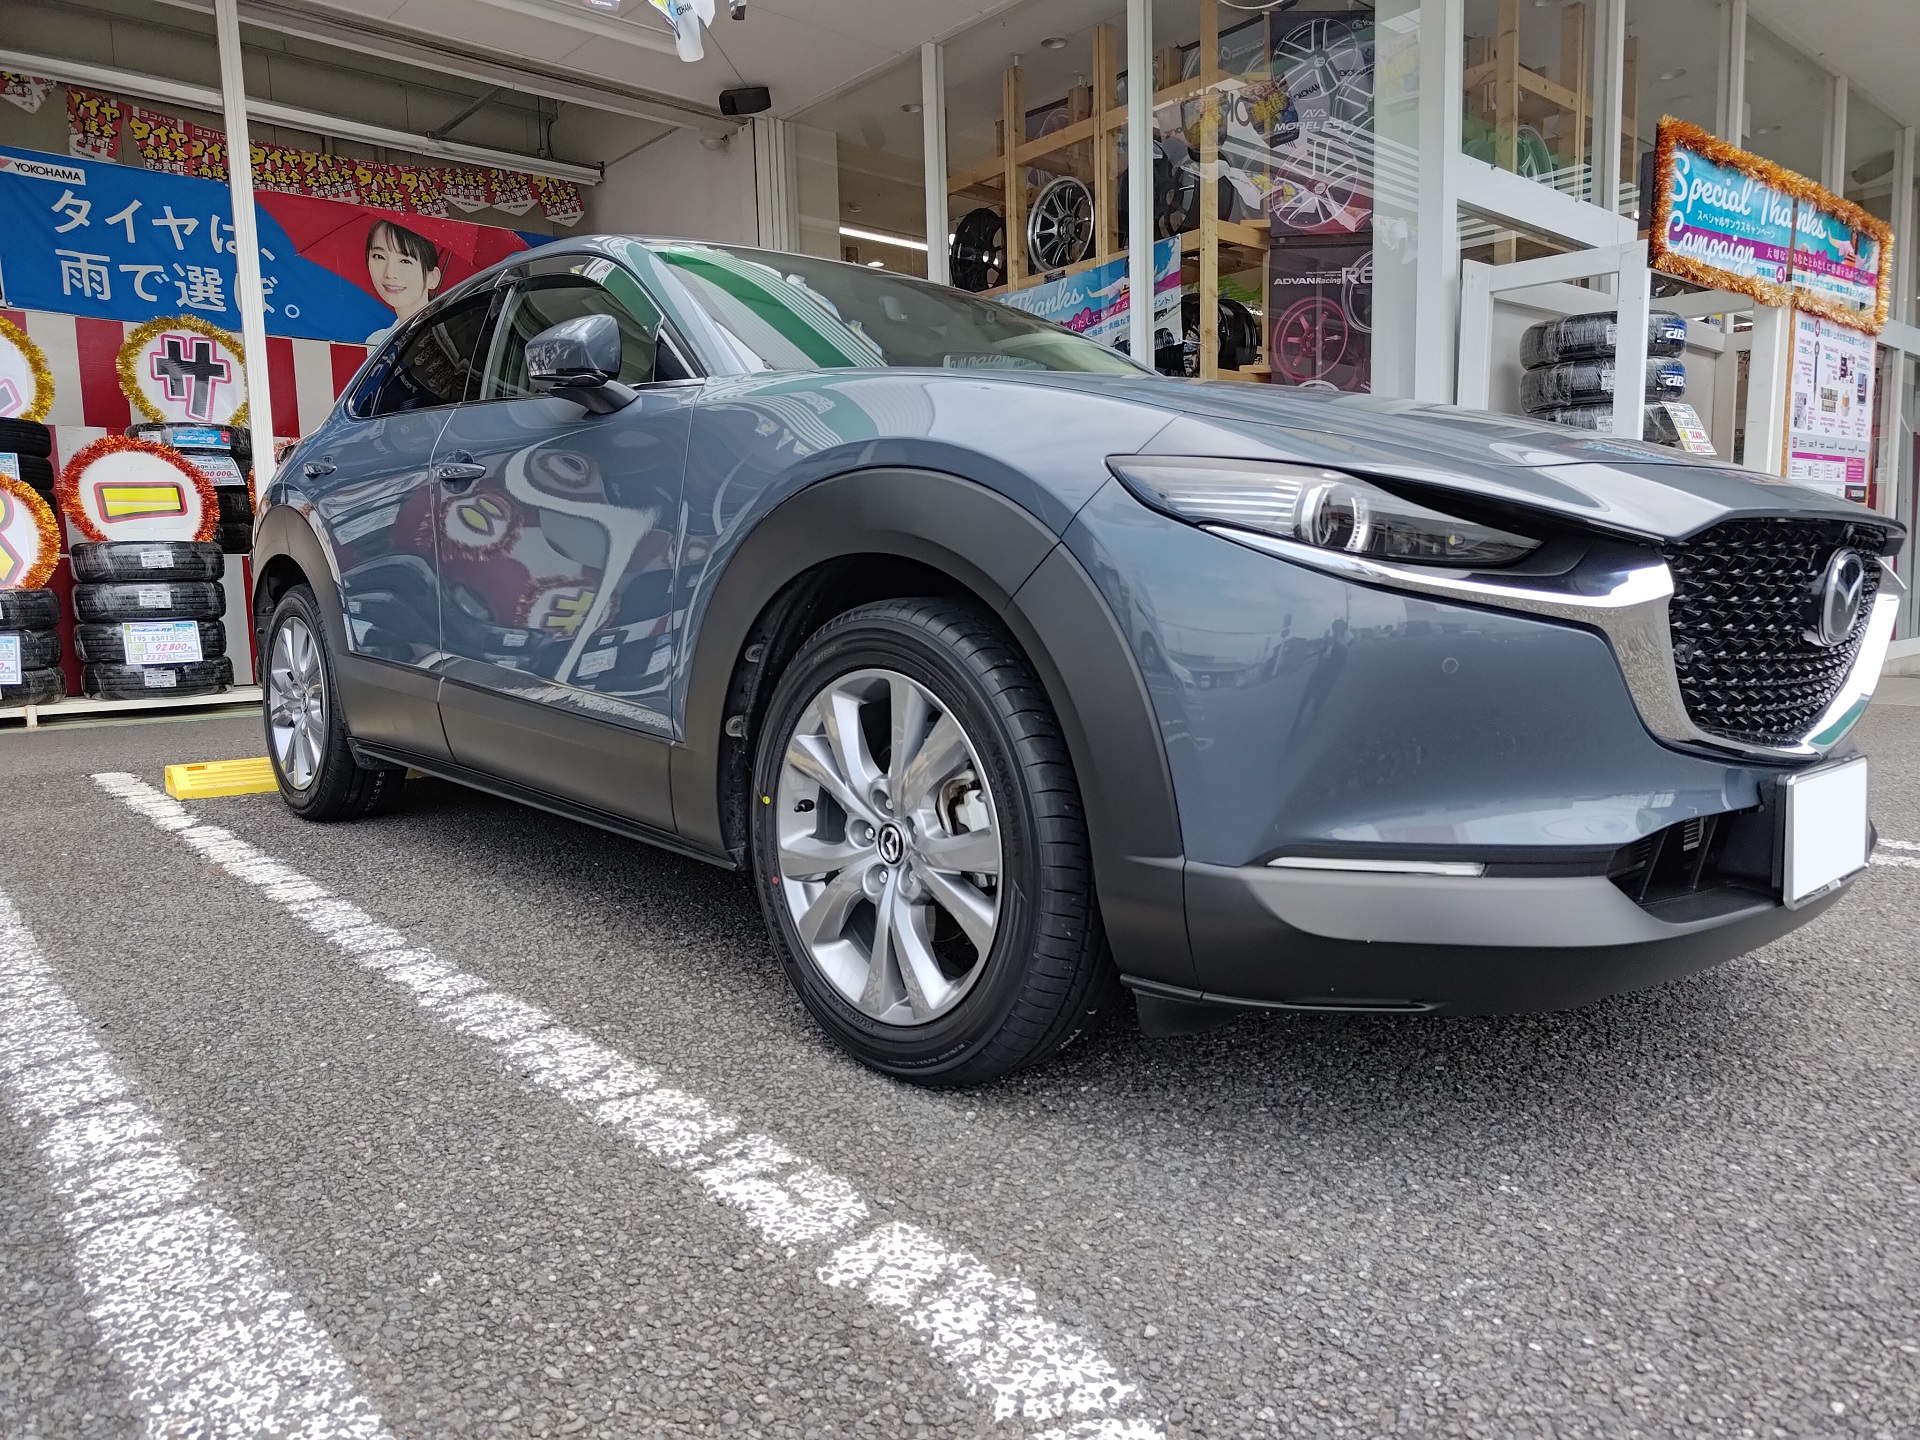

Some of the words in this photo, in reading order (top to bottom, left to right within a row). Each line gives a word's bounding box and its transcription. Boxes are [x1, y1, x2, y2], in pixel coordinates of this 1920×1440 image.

[140, 110, 175, 125] ヨコハマ
[1274, 121, 1320, 132] MODEL
[130, 116, 190, 148] タイヤ
[249, 143, 302, 170] タイヤ
[360, 161, 388, 170] ヨコハマ
[14, 161, 82, 182] YOKOHAMA
[305, 166, 354, 187] 大商談会
[355, 164, 400, 190] タイヤ
[442, 171, 488, 188] 大商談会
[490, 173, 528, 193] 大商談会
[540, 185, 578, 206] 大商談会
[1670, 151, 1752, 214] Special
[1754, 183, 1827, 240] Thanks
[1697, 210, 1776, 239] スペシャルサンクスキャンペーン
[1667, 211, 1757, 275] Campaign
[151, 334, 231, 422] サ
